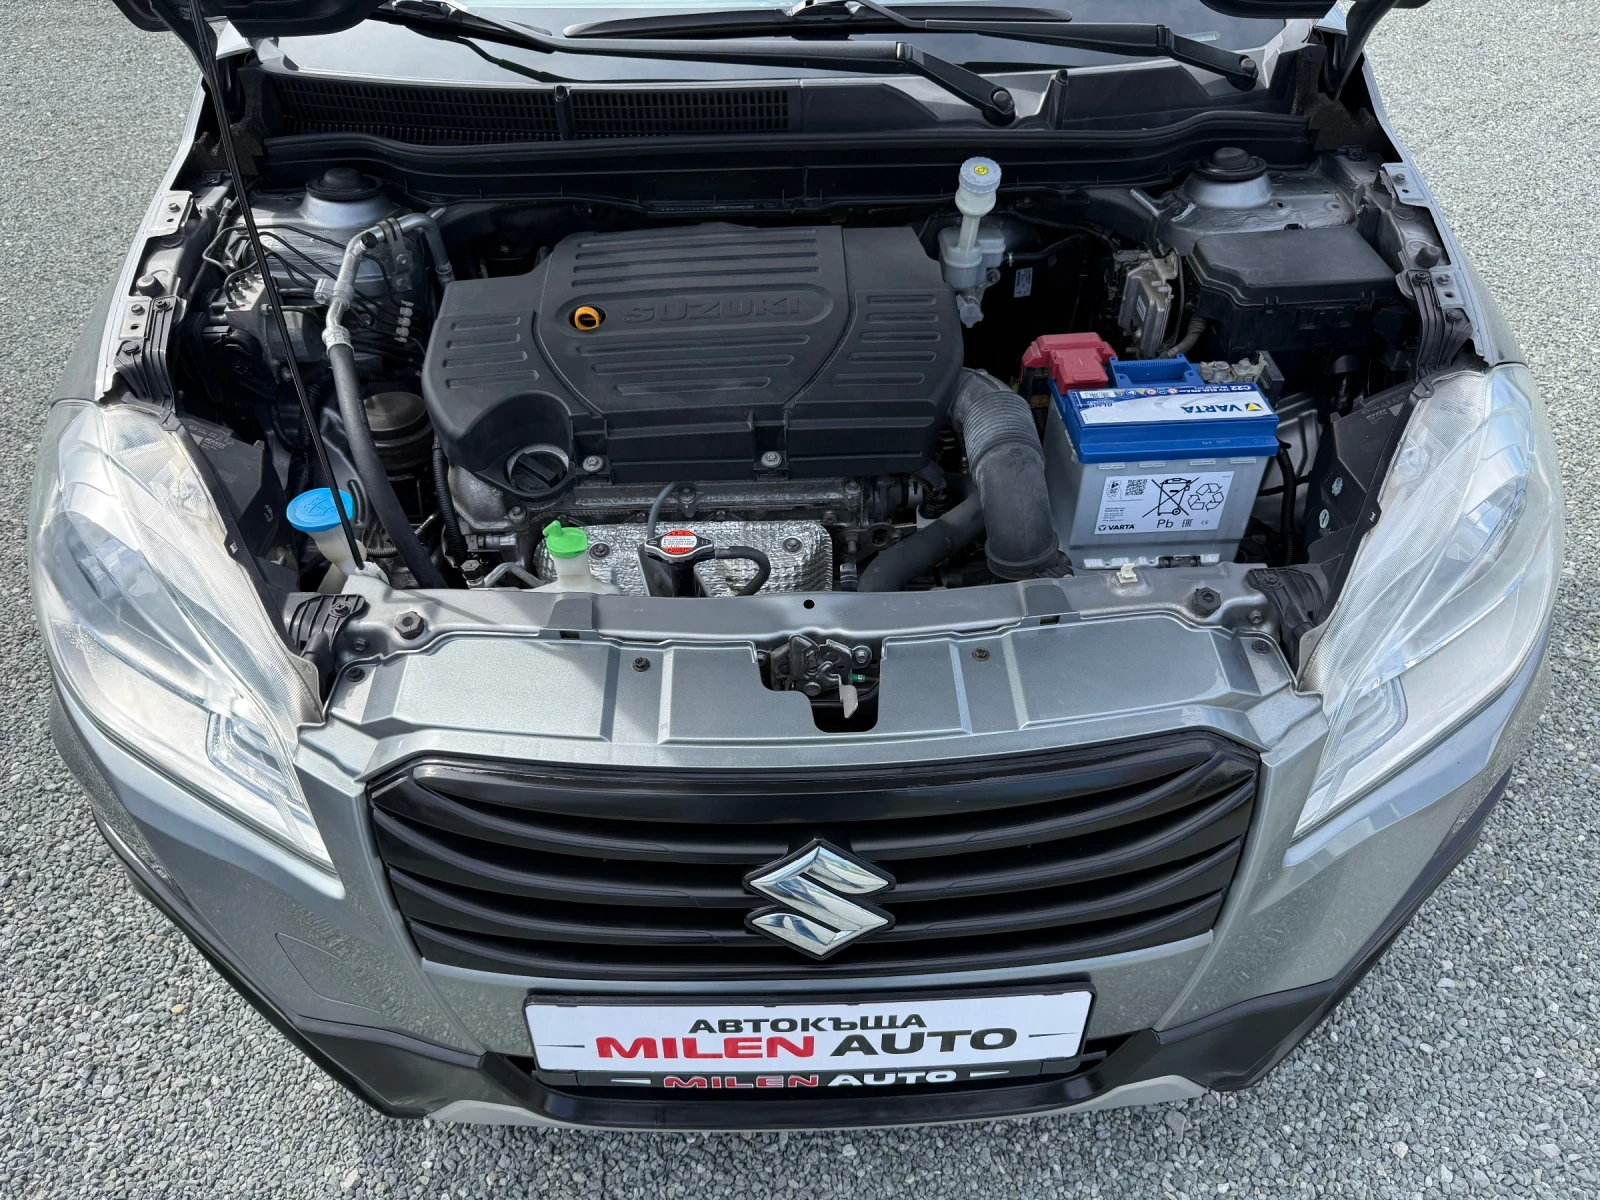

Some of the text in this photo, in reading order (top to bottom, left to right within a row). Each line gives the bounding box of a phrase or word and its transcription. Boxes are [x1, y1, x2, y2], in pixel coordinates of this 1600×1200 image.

[622, 297, 800, 324] SUZUKI
[1180, 404, 1243, 413] VARTA
[1156, 518, 1174, 529] Pb
[595, 1027, 1018, 1059] MILEN AUTO
[663, 1070, 957, 1088] MILEN AUTO
